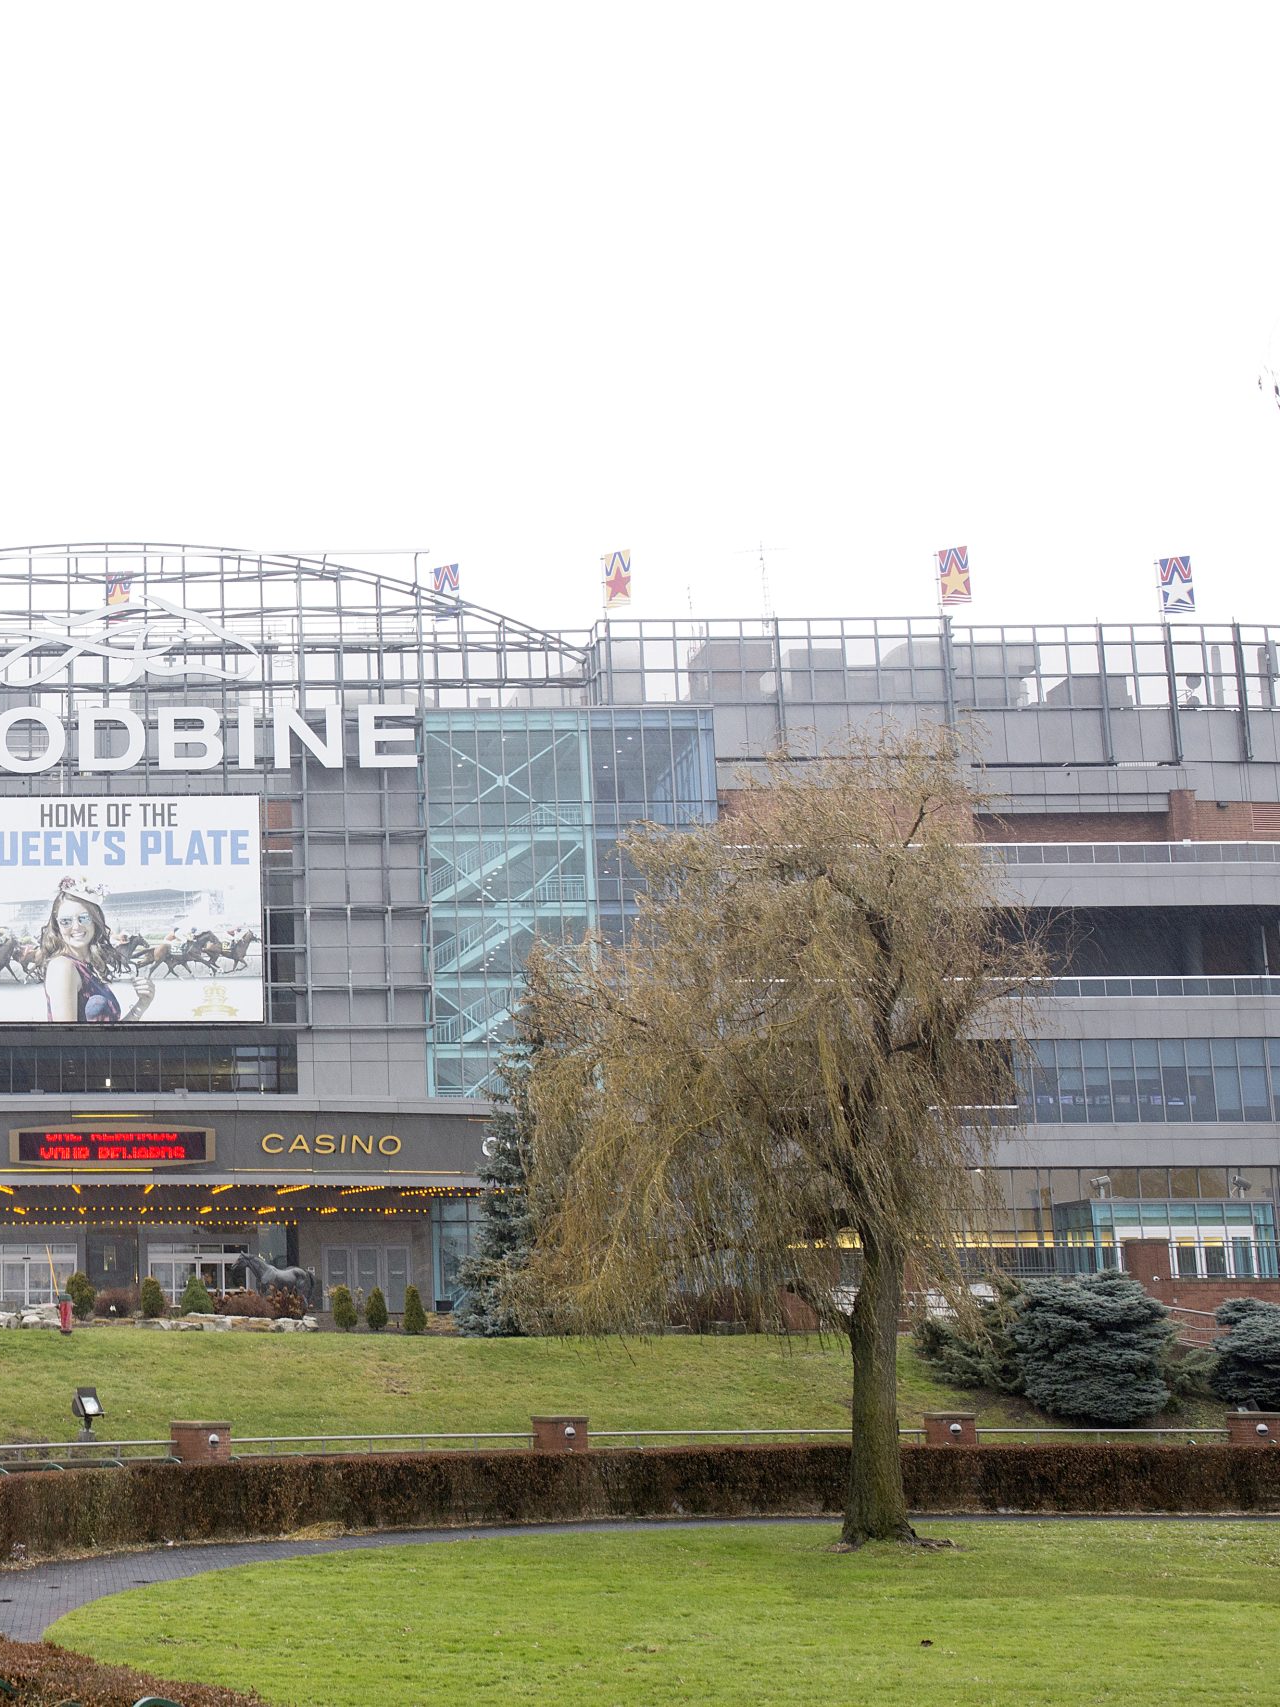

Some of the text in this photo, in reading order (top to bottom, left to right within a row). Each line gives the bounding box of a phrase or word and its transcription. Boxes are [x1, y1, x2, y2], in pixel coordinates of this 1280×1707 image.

[40, 802, 178, 828] HOME OF THE
[140, 829, 250, 865] PLATE
[261, 1133, 403, 1156] CASINO
